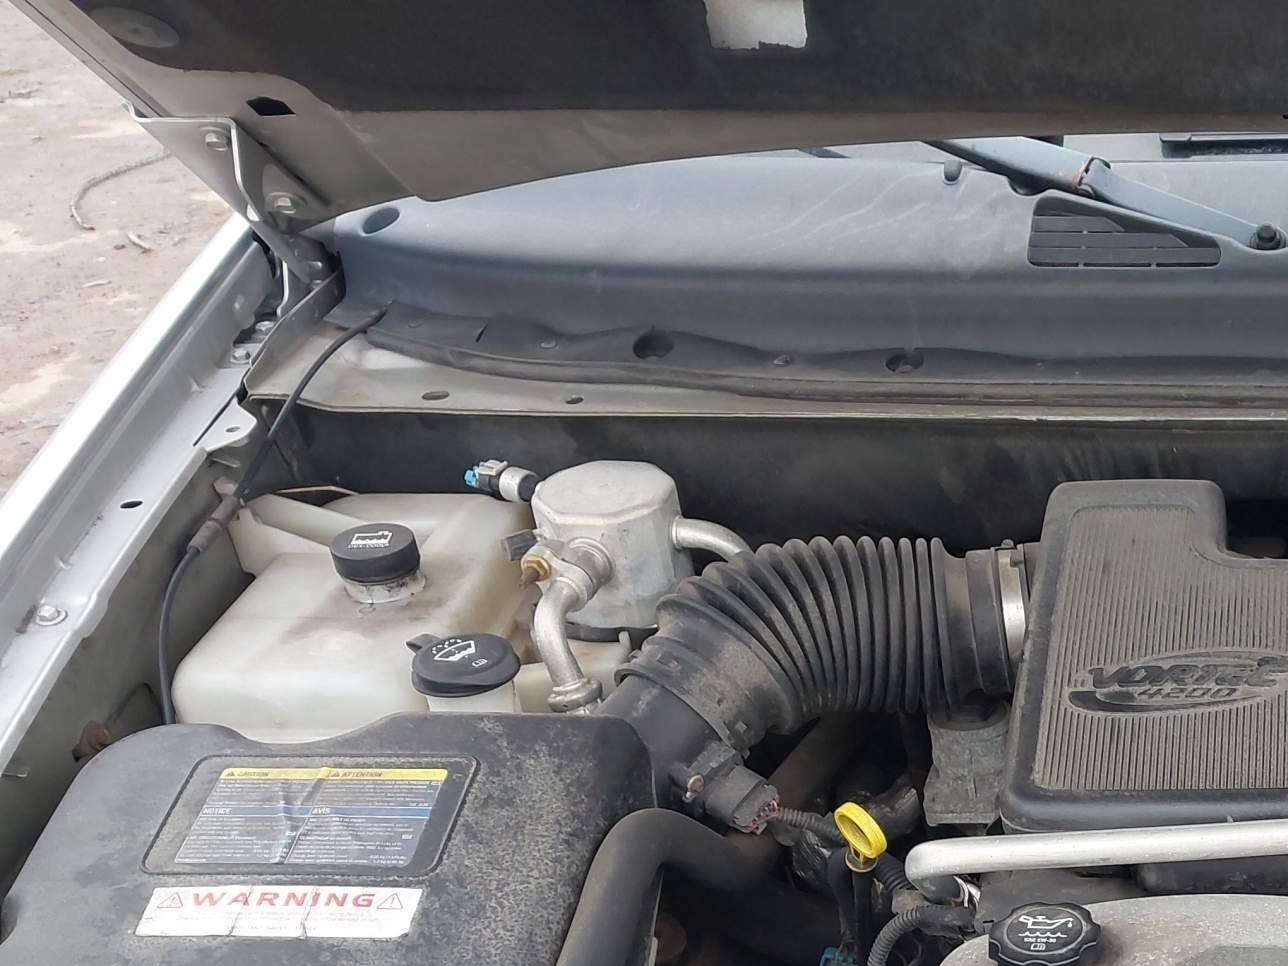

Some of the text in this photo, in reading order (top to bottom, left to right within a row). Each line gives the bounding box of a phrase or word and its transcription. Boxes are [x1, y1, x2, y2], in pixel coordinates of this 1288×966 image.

[1137, 687, 1237, 699] 4200
[311, 807, 331, 815] AVIS
[192, 892, 375, 908] WARNING
